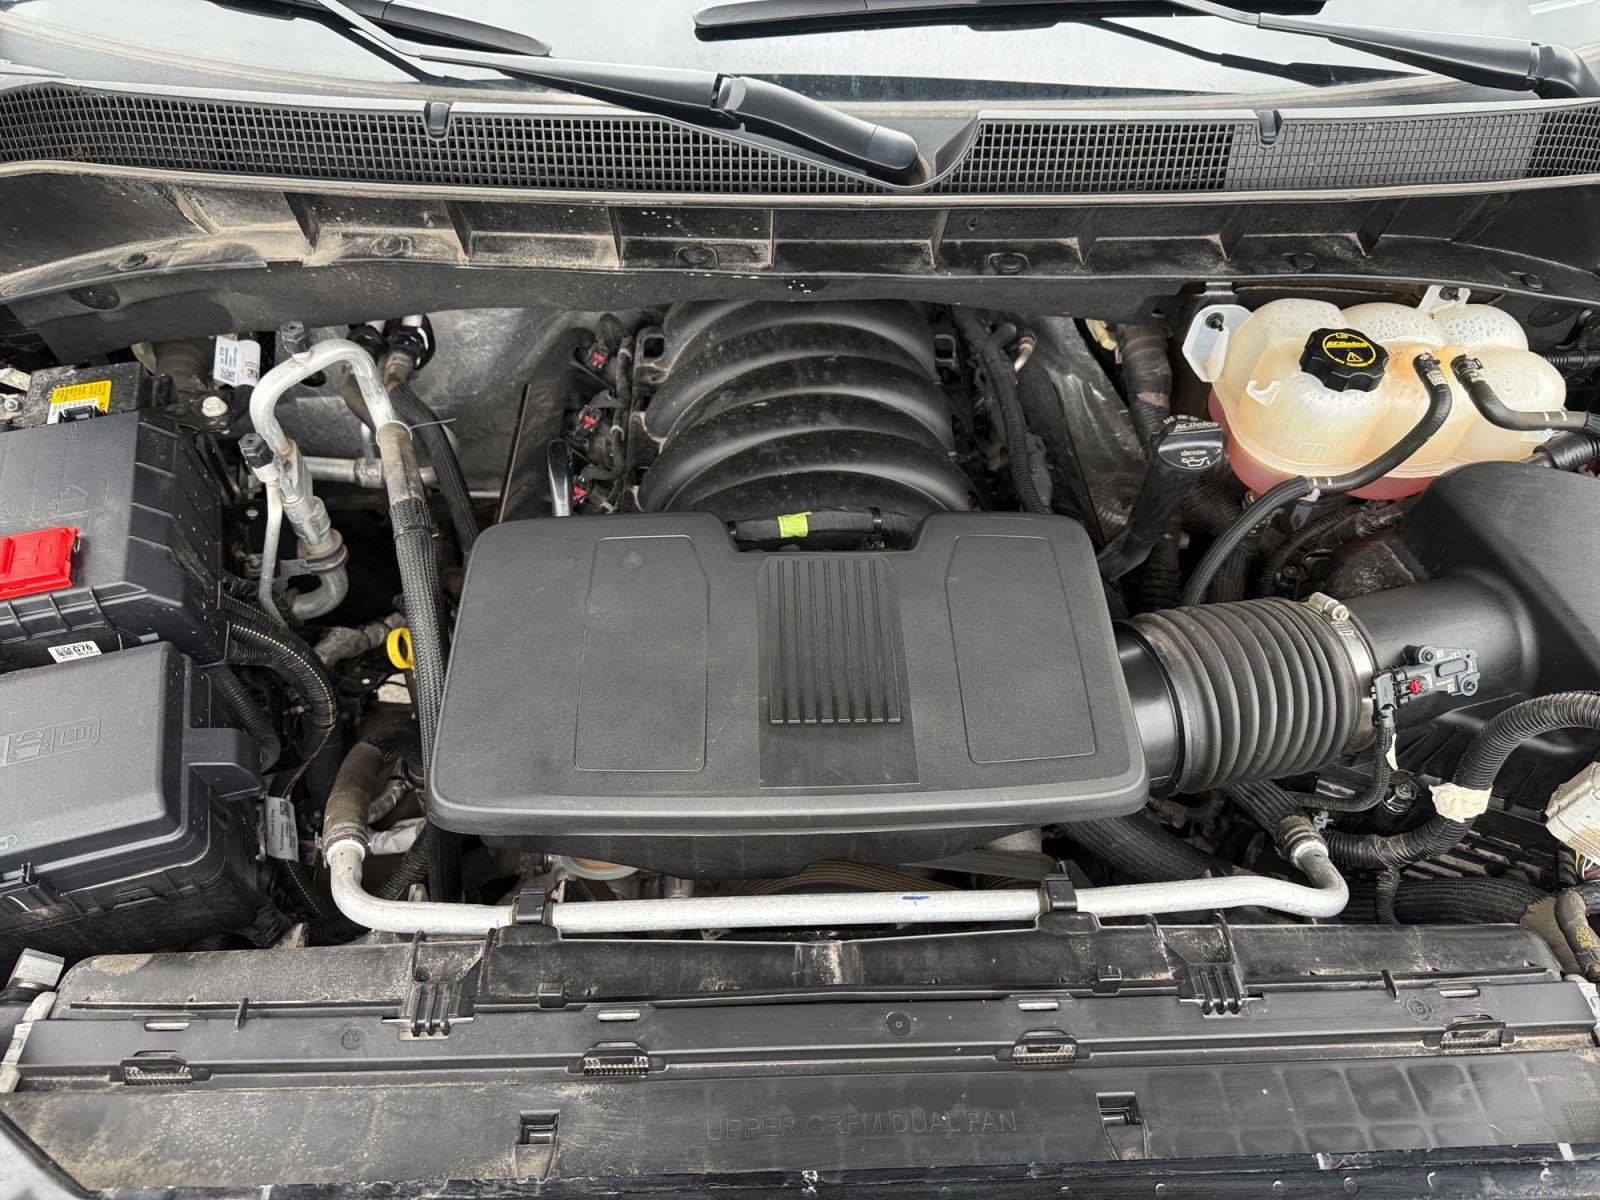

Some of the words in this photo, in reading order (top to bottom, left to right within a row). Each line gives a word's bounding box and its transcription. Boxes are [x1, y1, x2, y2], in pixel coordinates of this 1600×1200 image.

[1325, 340, 1369, 348] ACDelco
[1173, 421, 1219, 433] ACDelco
[1181, 449, 1207, 457] dexos
[707, 1115, 799, 1141] UPPER
[890, 1110, 961, 1133] DUAL
[968, 1109, 1017, 1132] FAN
